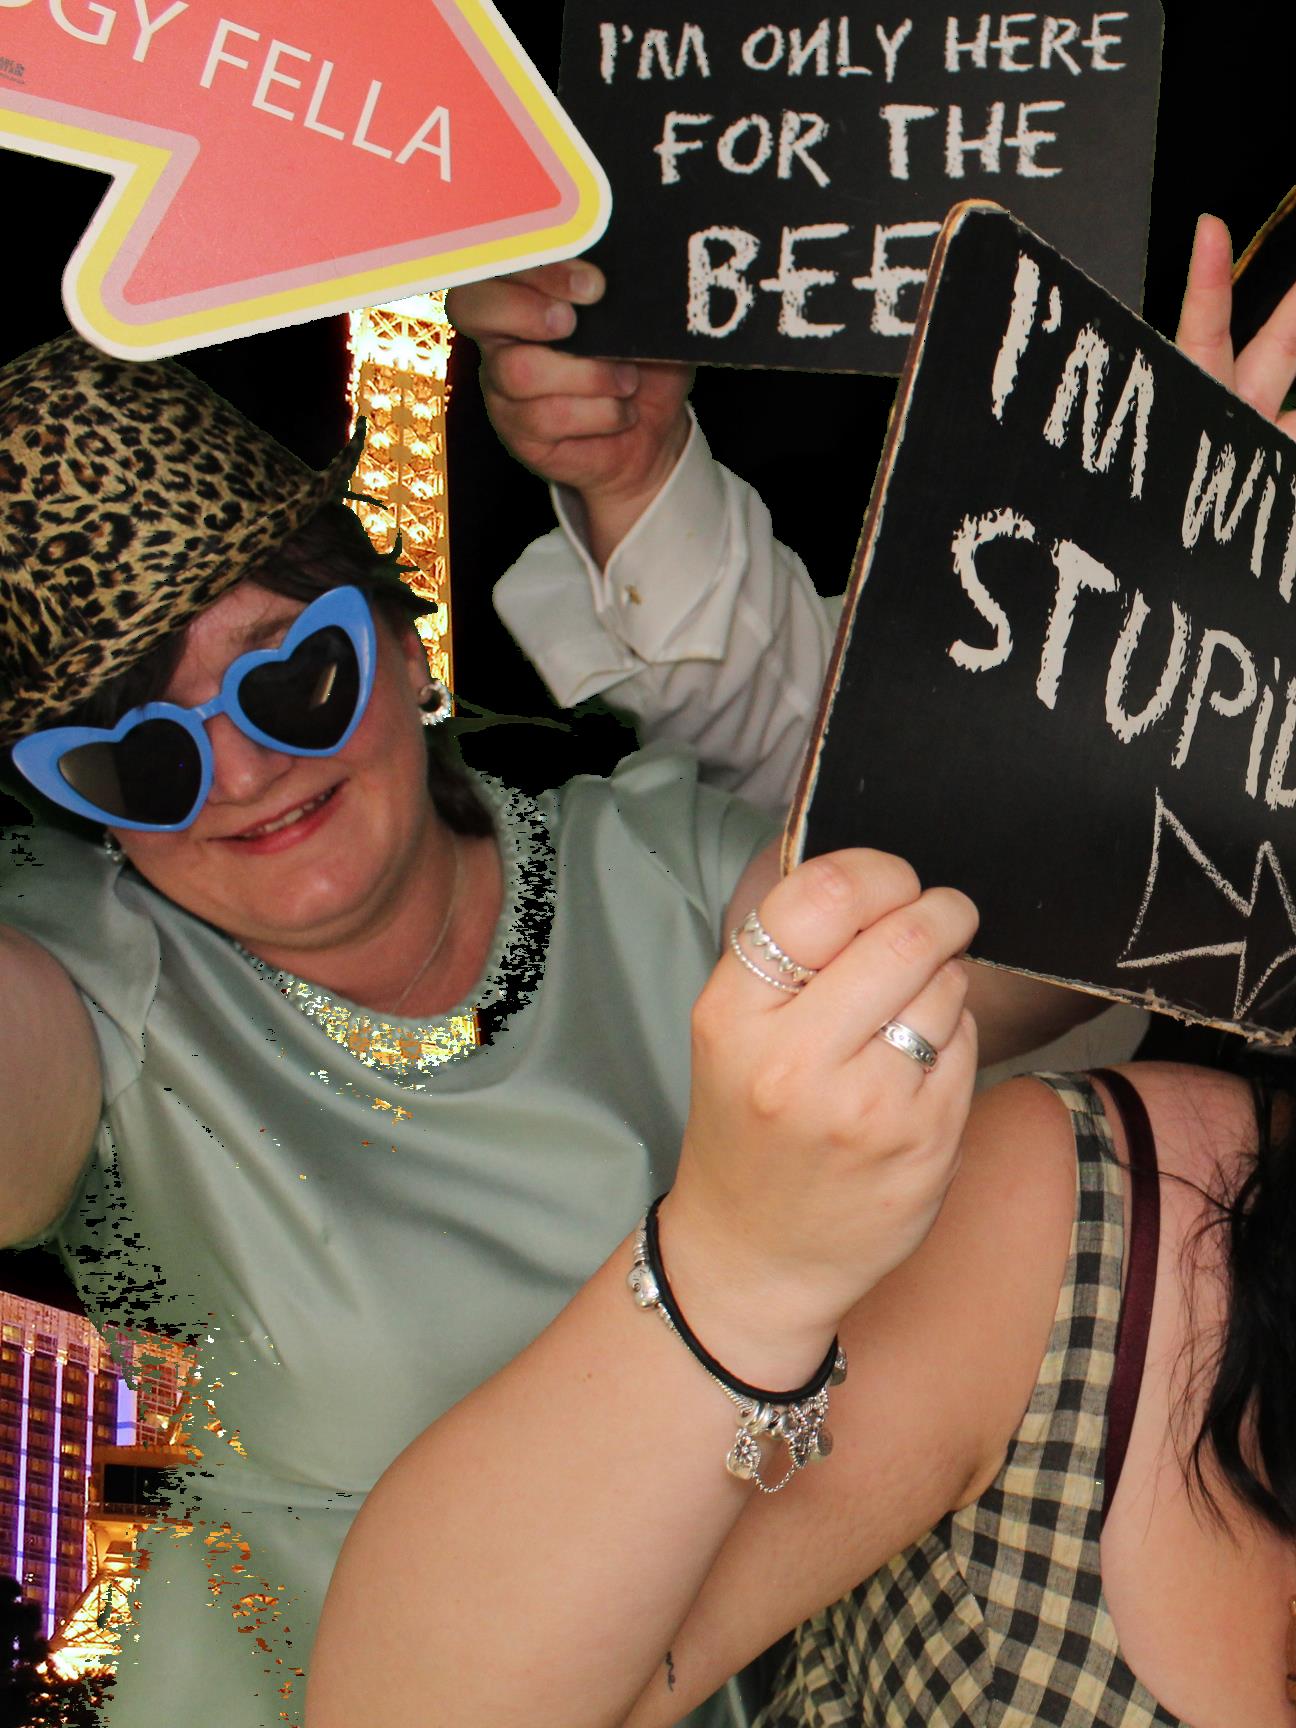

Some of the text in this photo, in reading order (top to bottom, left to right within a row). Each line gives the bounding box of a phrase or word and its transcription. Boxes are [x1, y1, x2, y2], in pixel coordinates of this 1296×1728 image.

[0, 0, 452, 182] GY FELLA
[601, 12, 1130, 83] I'M ONLY HERE
[653, 101, 1066, 187] FOR THE
[991, 252, 1155, 498] I'M
